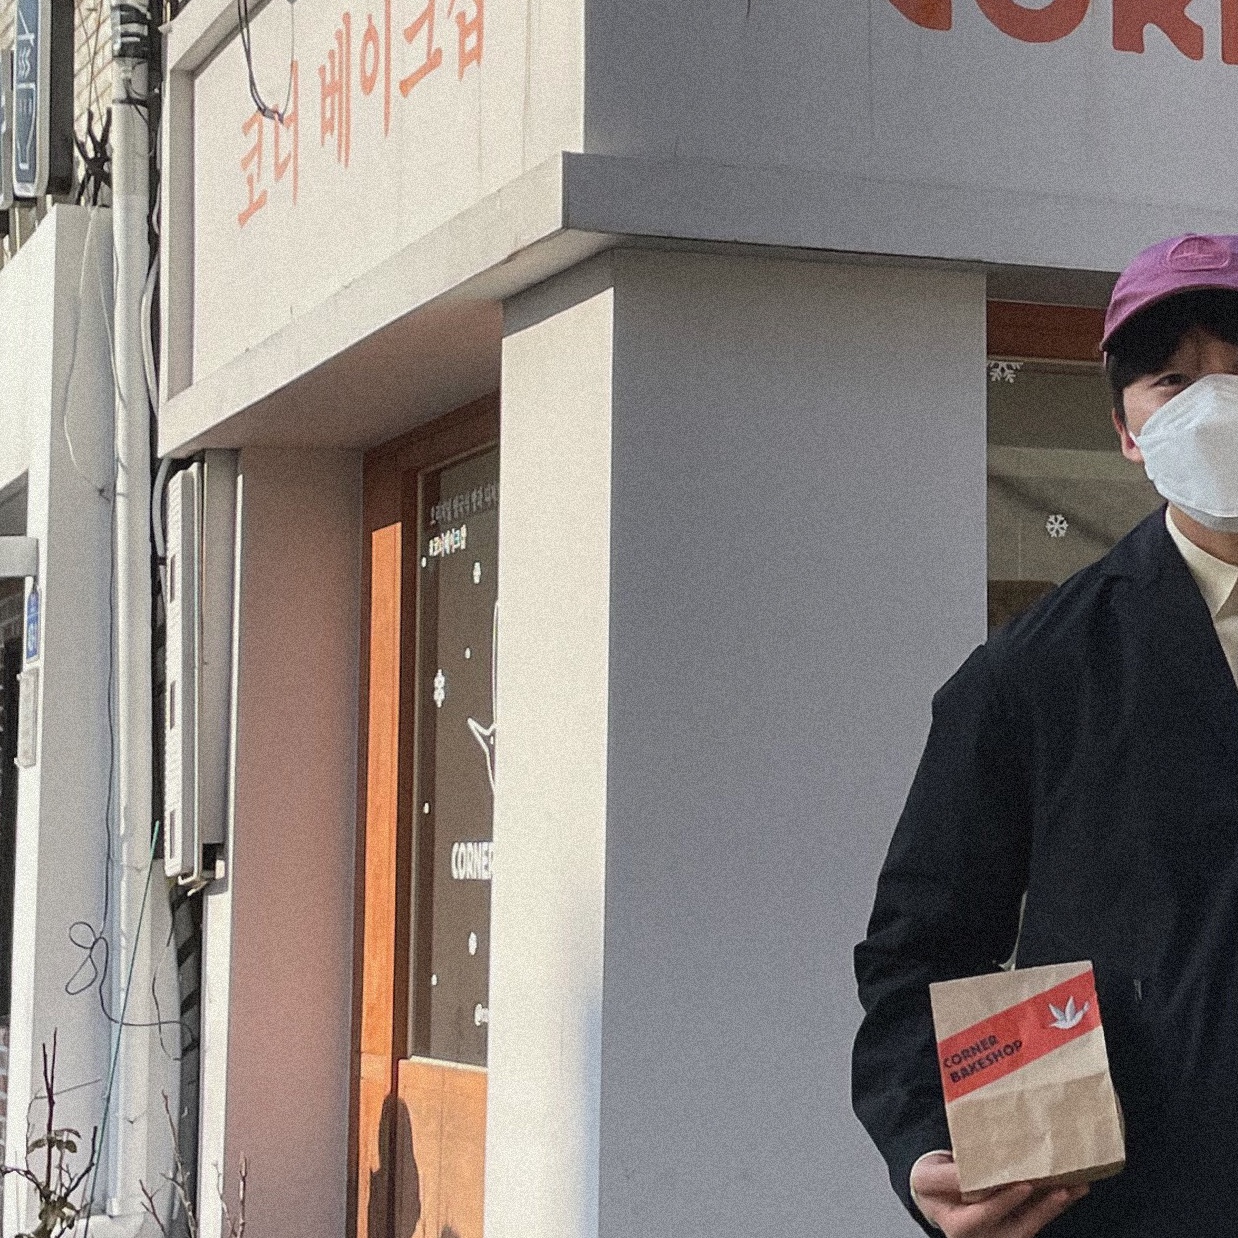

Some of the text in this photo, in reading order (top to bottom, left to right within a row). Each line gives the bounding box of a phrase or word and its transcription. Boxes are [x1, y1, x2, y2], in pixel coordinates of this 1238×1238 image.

[237, 60, 299, 229] 코너
[943, 1034, 998, 1068] CORNER
[949, 1040, 1023, 1083] BAKESHOP
